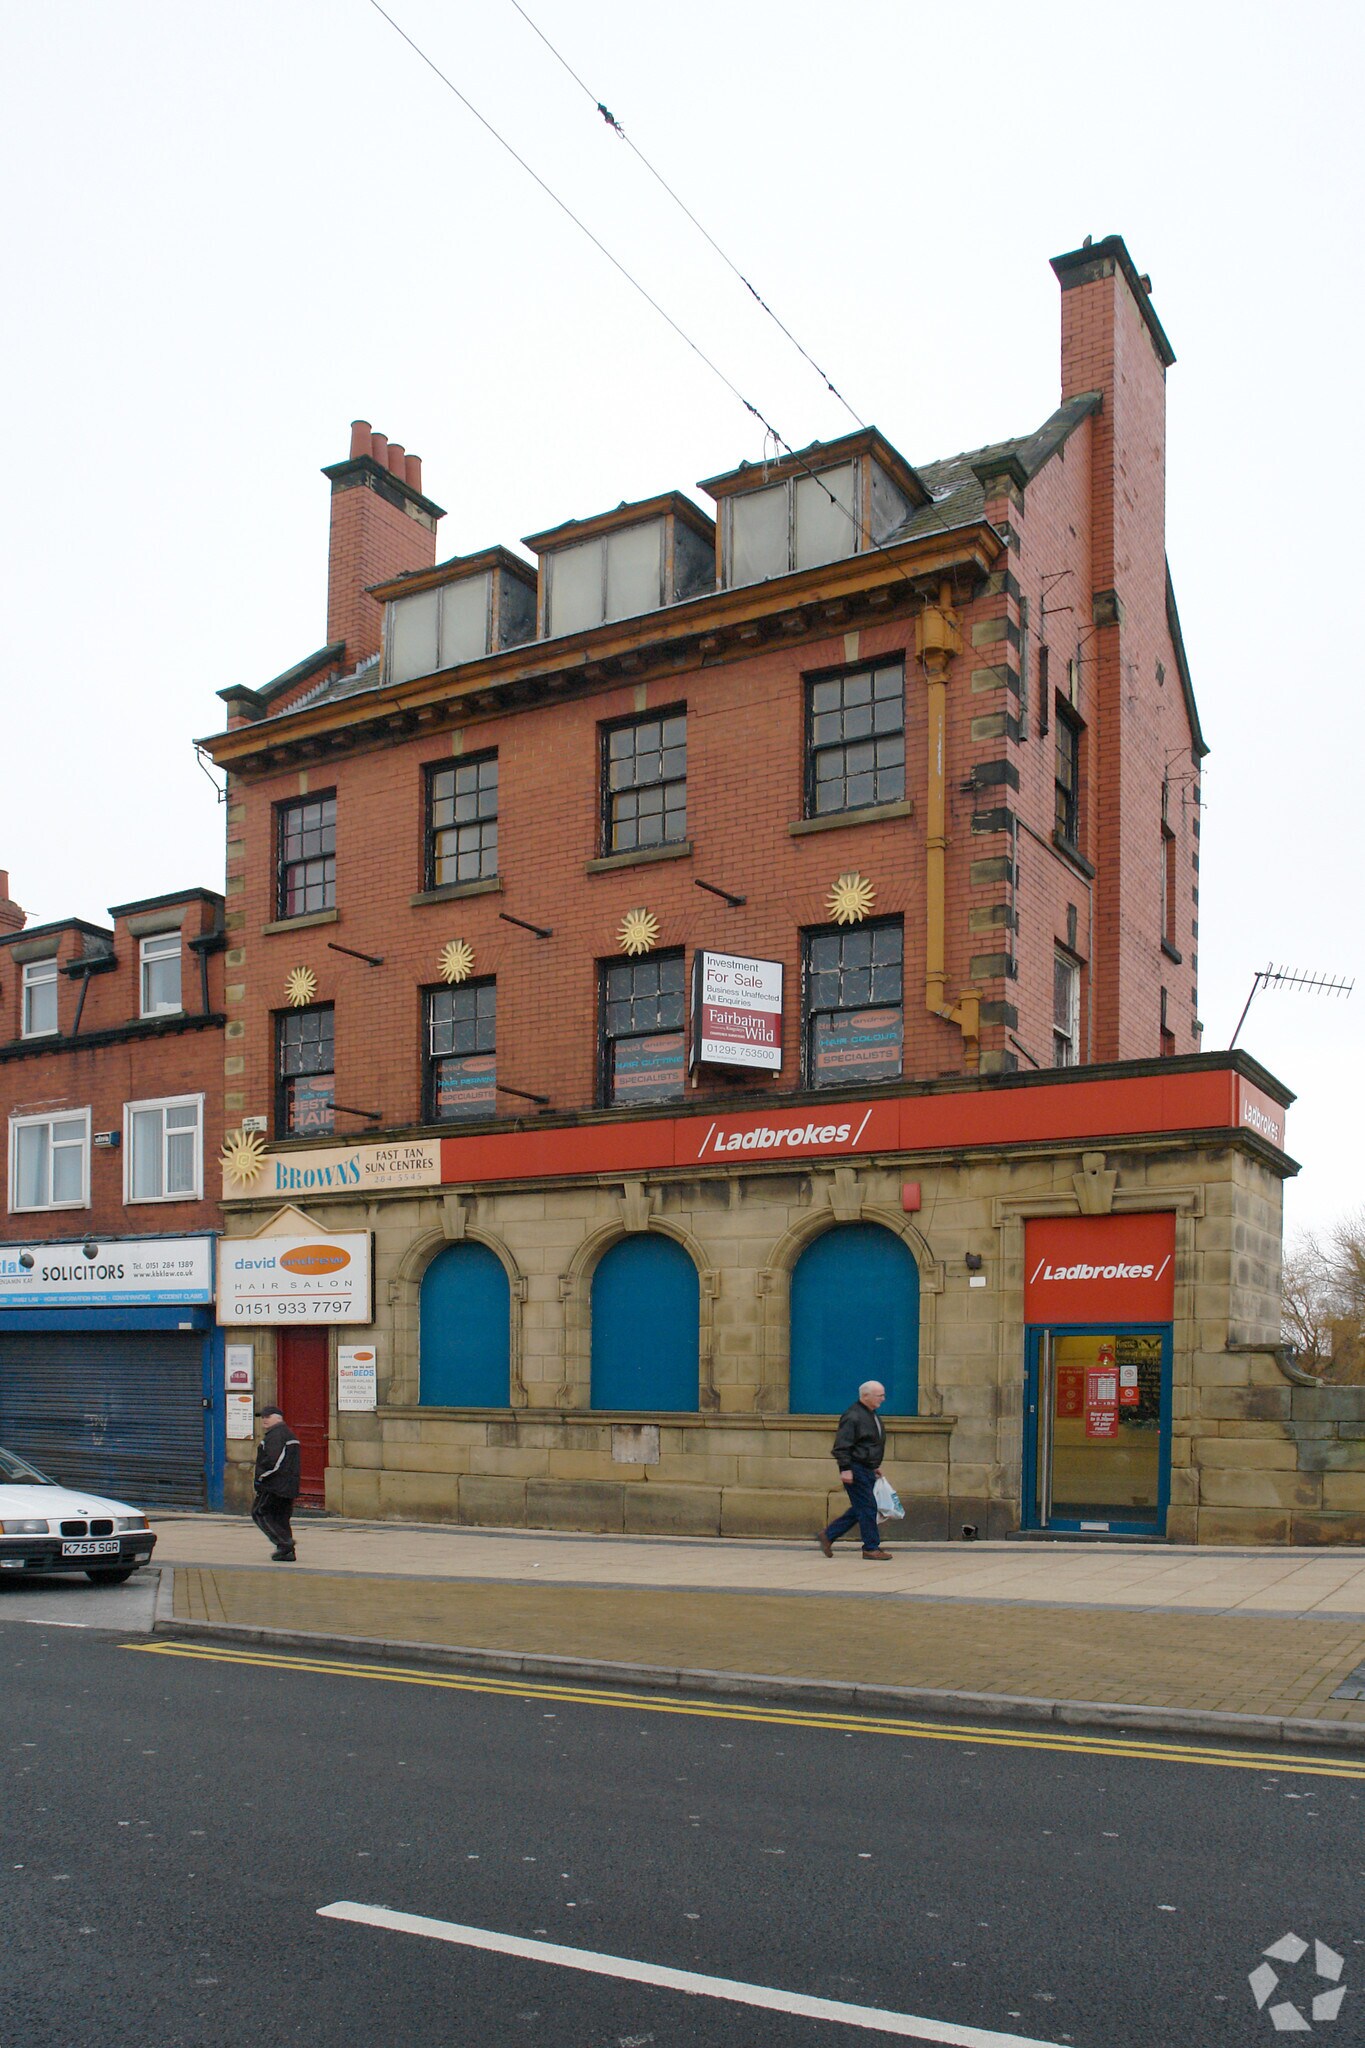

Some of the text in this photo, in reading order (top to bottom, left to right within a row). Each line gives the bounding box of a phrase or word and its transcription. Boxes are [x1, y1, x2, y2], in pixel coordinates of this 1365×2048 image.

[707, 956, 759, 972] Investment
[707, 969, 763, 988] For Sale
[706, 985, 780, 1002] Business Unaffected
[706, 994, 751, 1007] All Enquiries
[709, 1009, 765, 1028] Fairbairn
[817, 1015, 896, 1030] david andrew
[744, 1027, 774, 1042] Wild
[819, 1032, 897, 1047] HAIR COLOUR
[707, 1044, 737, 1056] 01295
[740, 1048, 774, 1060] 753500
[823, 1050, 893, 1064] SPECIALISTS
[616, 1056, 683, 1069] HAIR CUTTING
[438, 1079, 458, 1087] HAIR
[619, 1072, 679, 1085] SPECIALISTS
[442, 1090, 495, 1101] SPECIALISTS
[290, 1099, 329, 1111] BEST
[1244, 1100, 1280, 1140] Ladbrokes
[714, 1124, 851, 1152] Ladbrokes
[376, 1148, 424, 1161] FAST TAN
[276, 1153, 360, 1189] BROWNS
[365, 1158, 433, 1173] SUN CENTRES
[235, 1256, 344, 1269] david andrew
[42, 1264, 125, 1282] SOLICITORS
[1043, 1263, 1154, 1280] Ladbrokes
[235, 1280, 353, 1290] HAIR SALON
[235, 1301, 352, 1314] 0151 933 7797
[64, 1542, 118, 1554] K755 SGR
